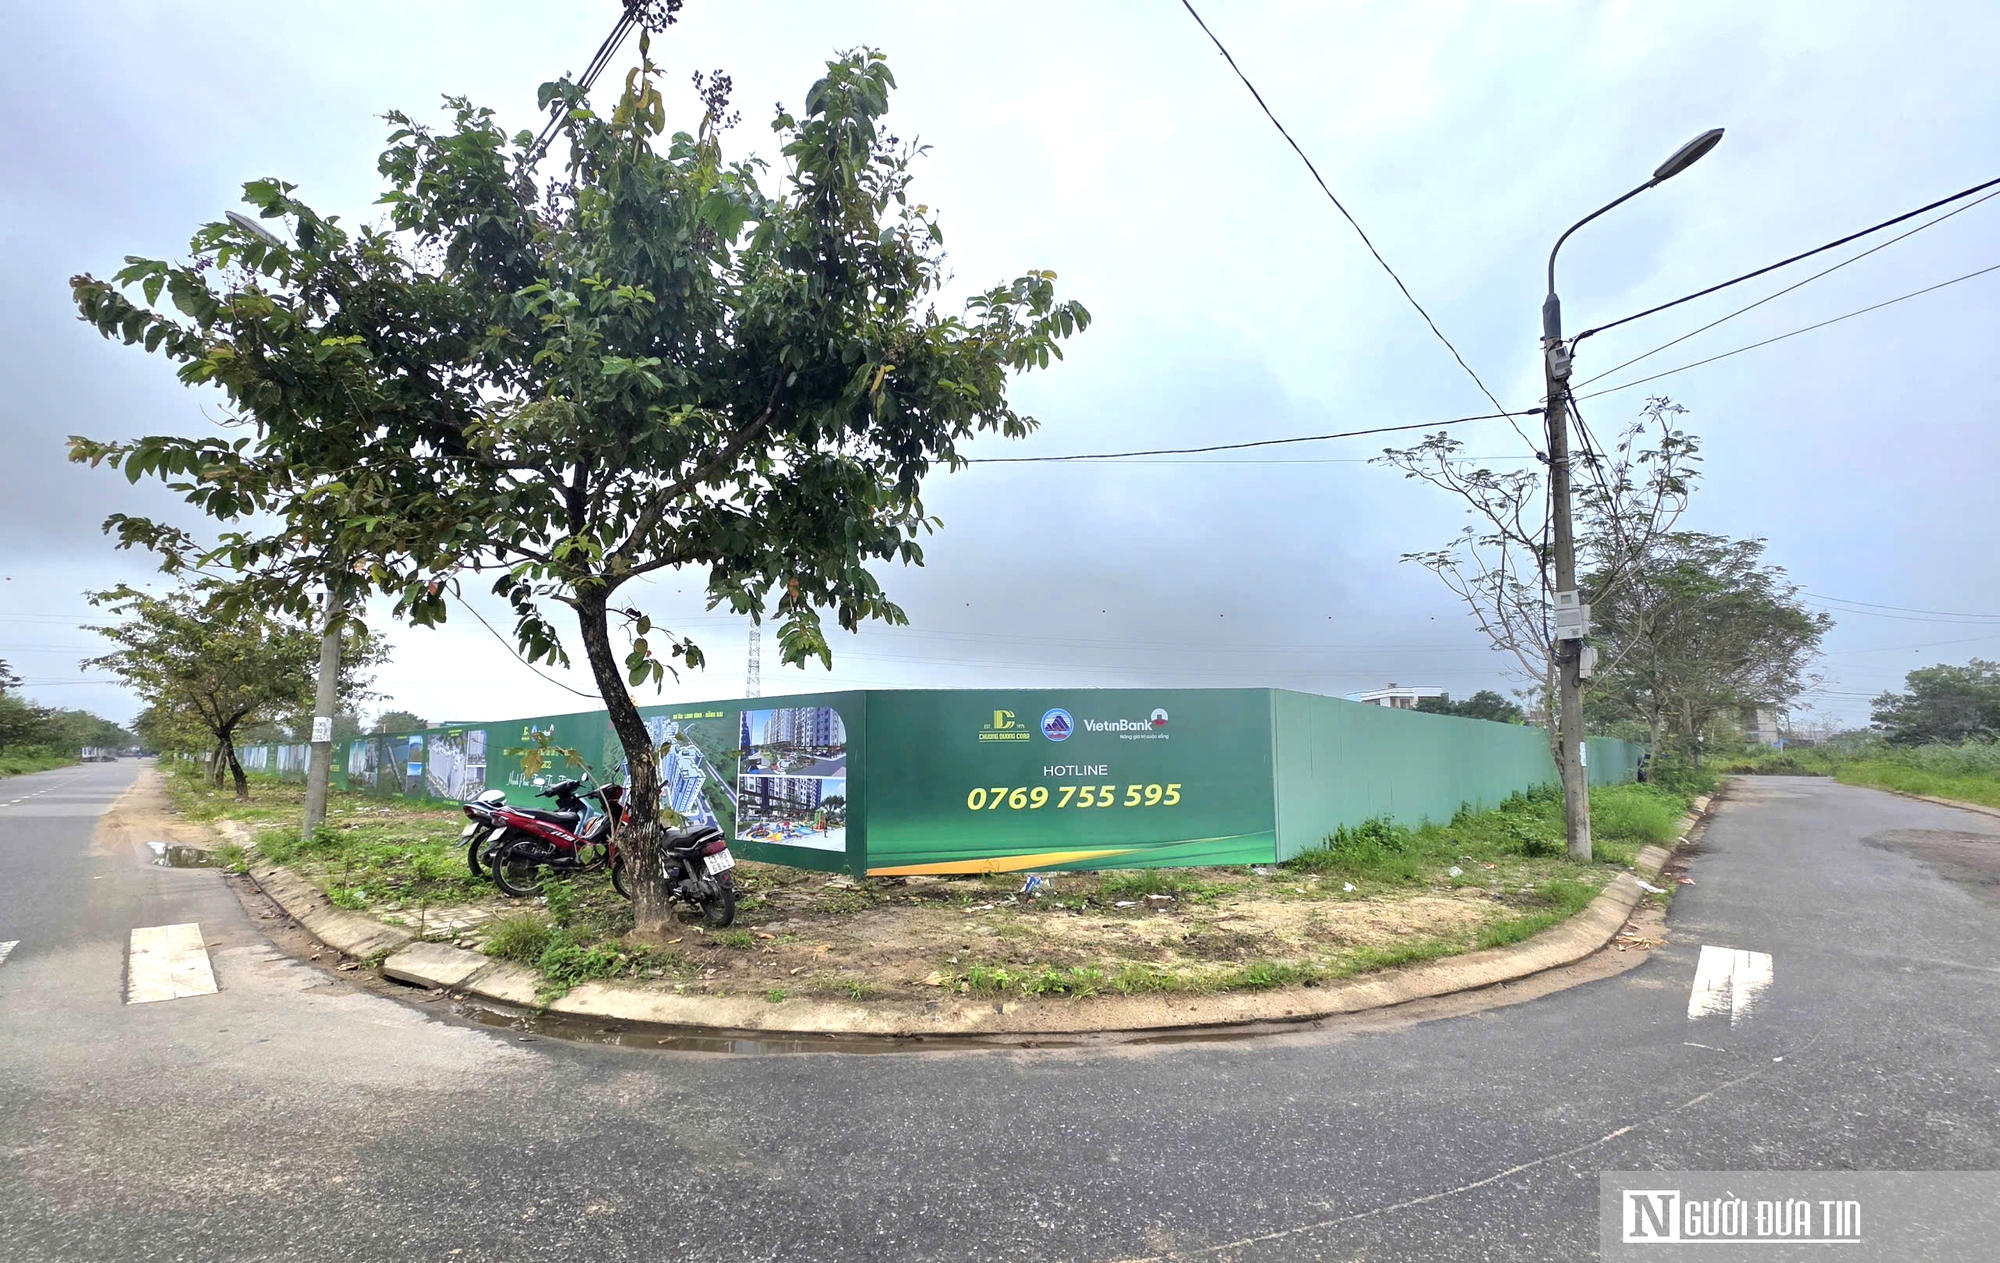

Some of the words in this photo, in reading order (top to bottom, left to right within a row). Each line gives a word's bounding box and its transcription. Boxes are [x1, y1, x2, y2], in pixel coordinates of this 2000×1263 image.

[1083, 718, 1153, 732] VietinBank
[1043, 764, 1109, 777] HOTLINE
[967, 786, 1049, 811] 0769
[1056, 785, 1116, 809] 755
[1123, 783, 1182, 807] 595
